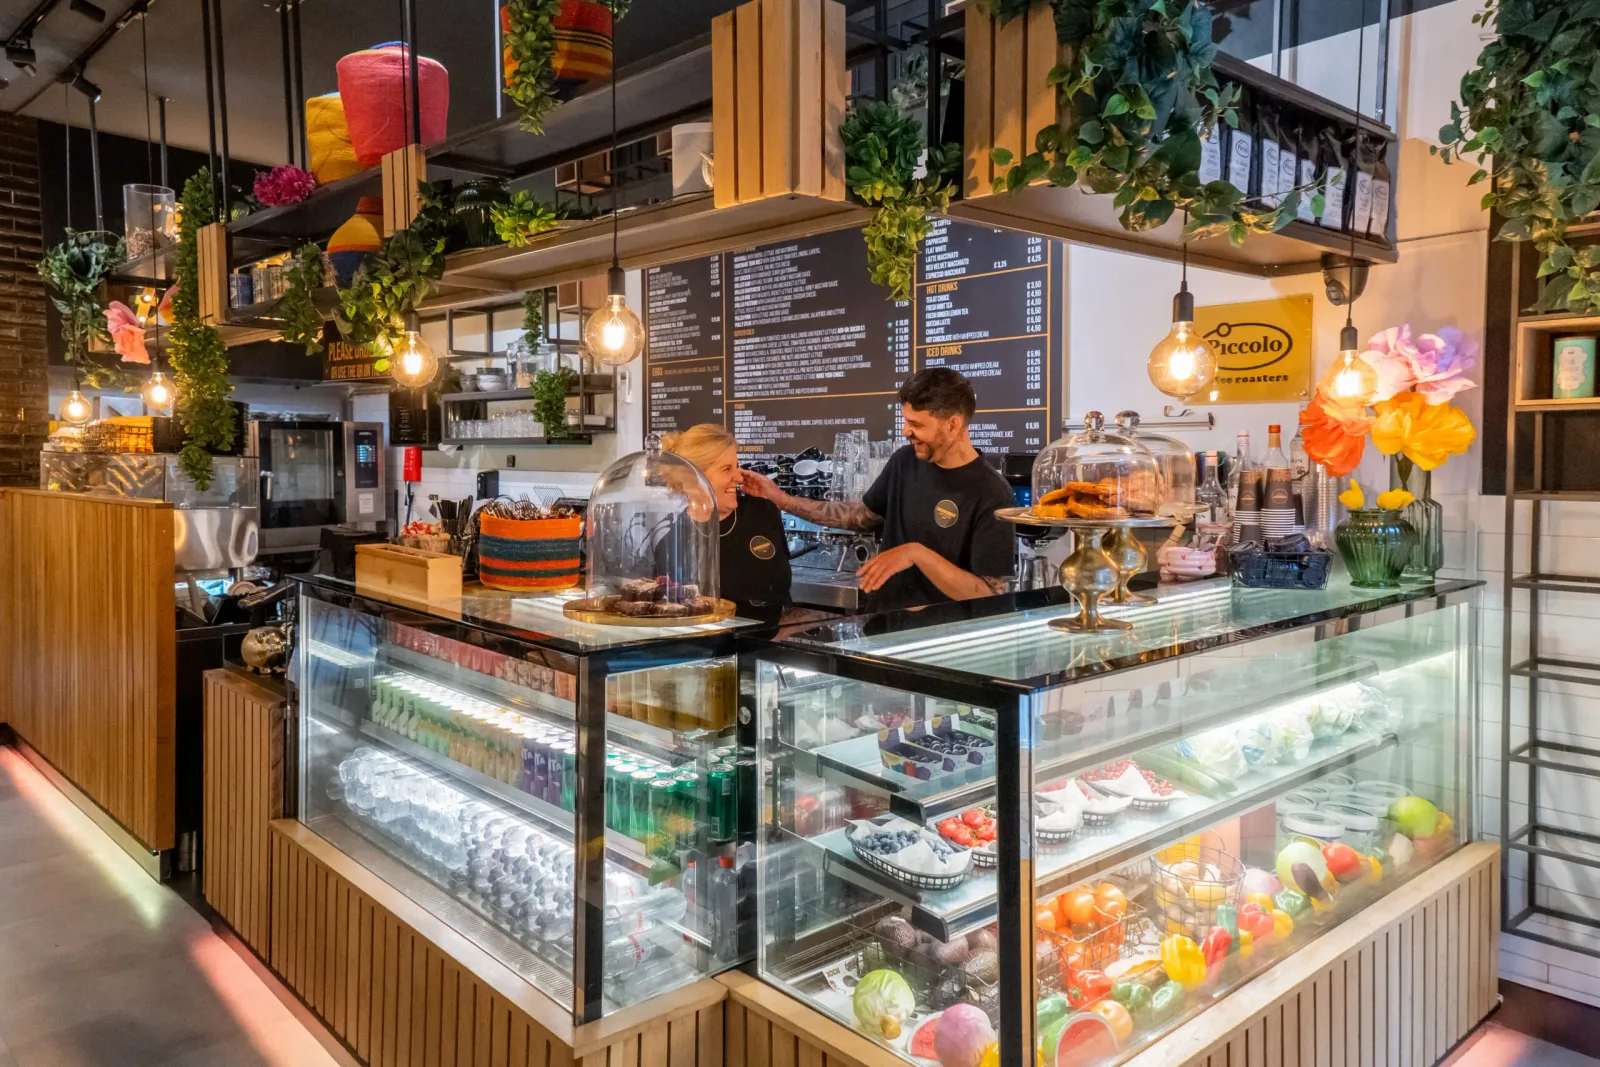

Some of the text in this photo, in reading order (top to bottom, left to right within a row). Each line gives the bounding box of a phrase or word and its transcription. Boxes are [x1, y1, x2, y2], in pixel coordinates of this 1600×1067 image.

[925, 235, 948, 246] CAPPUCCINO
[925, 244, 946, 254] FLAT WHITE
[925, 251, 958, 262] LATTE MACCHIATO
[934, 261, 946, 269] VELVET
[947, 257, 969, 267] MACCHIATO
[925, 270, 944, 279] ESPRESSO
[926, 281, 958, 294] HOT DRINKS
[1031, 280, 1041, 288] 3,50
[1031, 288, 1041, 297] 4,50
[1031, 297, 1041, 305] 4,50
[926, 303, 936, 311] FRESH
[926, 311, 936, 319] FRESH
[934, 326, 944, 334] LATTE
[933, 334, 952, 342] CHOCOLATE
[1207, 336, 1283, 355] Piccolo
[329, 341, 354, 361] PLEASE
[926, 344, 962, 357] ICED DRINKS
[934, 357, 945, 365] LATTE
[348, 365, 356, 377] THE
[987, 368, 1001, 376] CREAM
[1235, 374, 1289, 384] roasters
